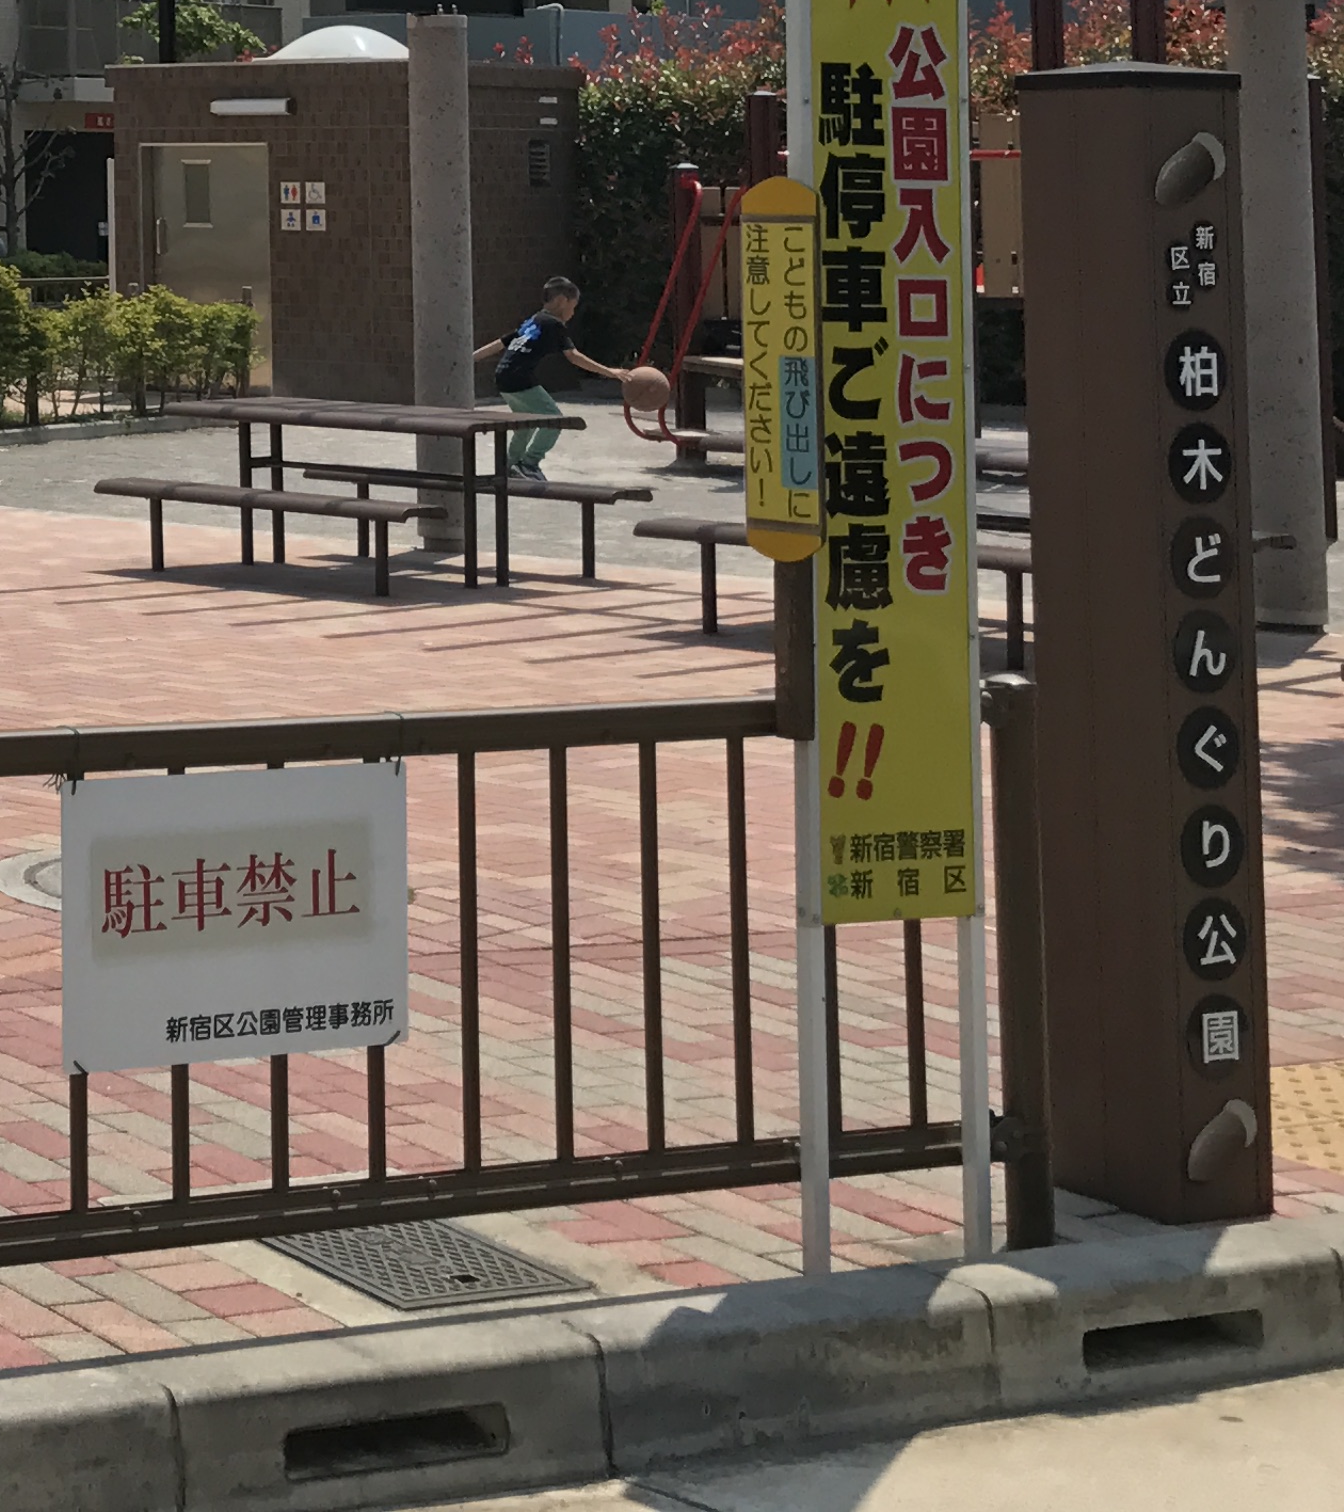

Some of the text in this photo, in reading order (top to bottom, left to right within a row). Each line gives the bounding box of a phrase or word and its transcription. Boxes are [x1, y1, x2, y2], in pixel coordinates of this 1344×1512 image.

[1170, 246, 1192, 306] 区立
[1195, 224, 1216, 287] 新宿
[889, 25, 952, 590] 公園入口につき
[746, 224, 773, 507] 注意してください!
[783, 226, 811, 519] こどもの飛び出しに
[1179, 346, 1240, 1065] 柏木どんぐり公園
[850, 829, 965, 863] 新宿警察署
[850, 865, 966, 900] 新宿区
[101, 849, 360, 938] 駐車禁止
[165, 998, 395, 1043] 新宿区公園管理事務所
